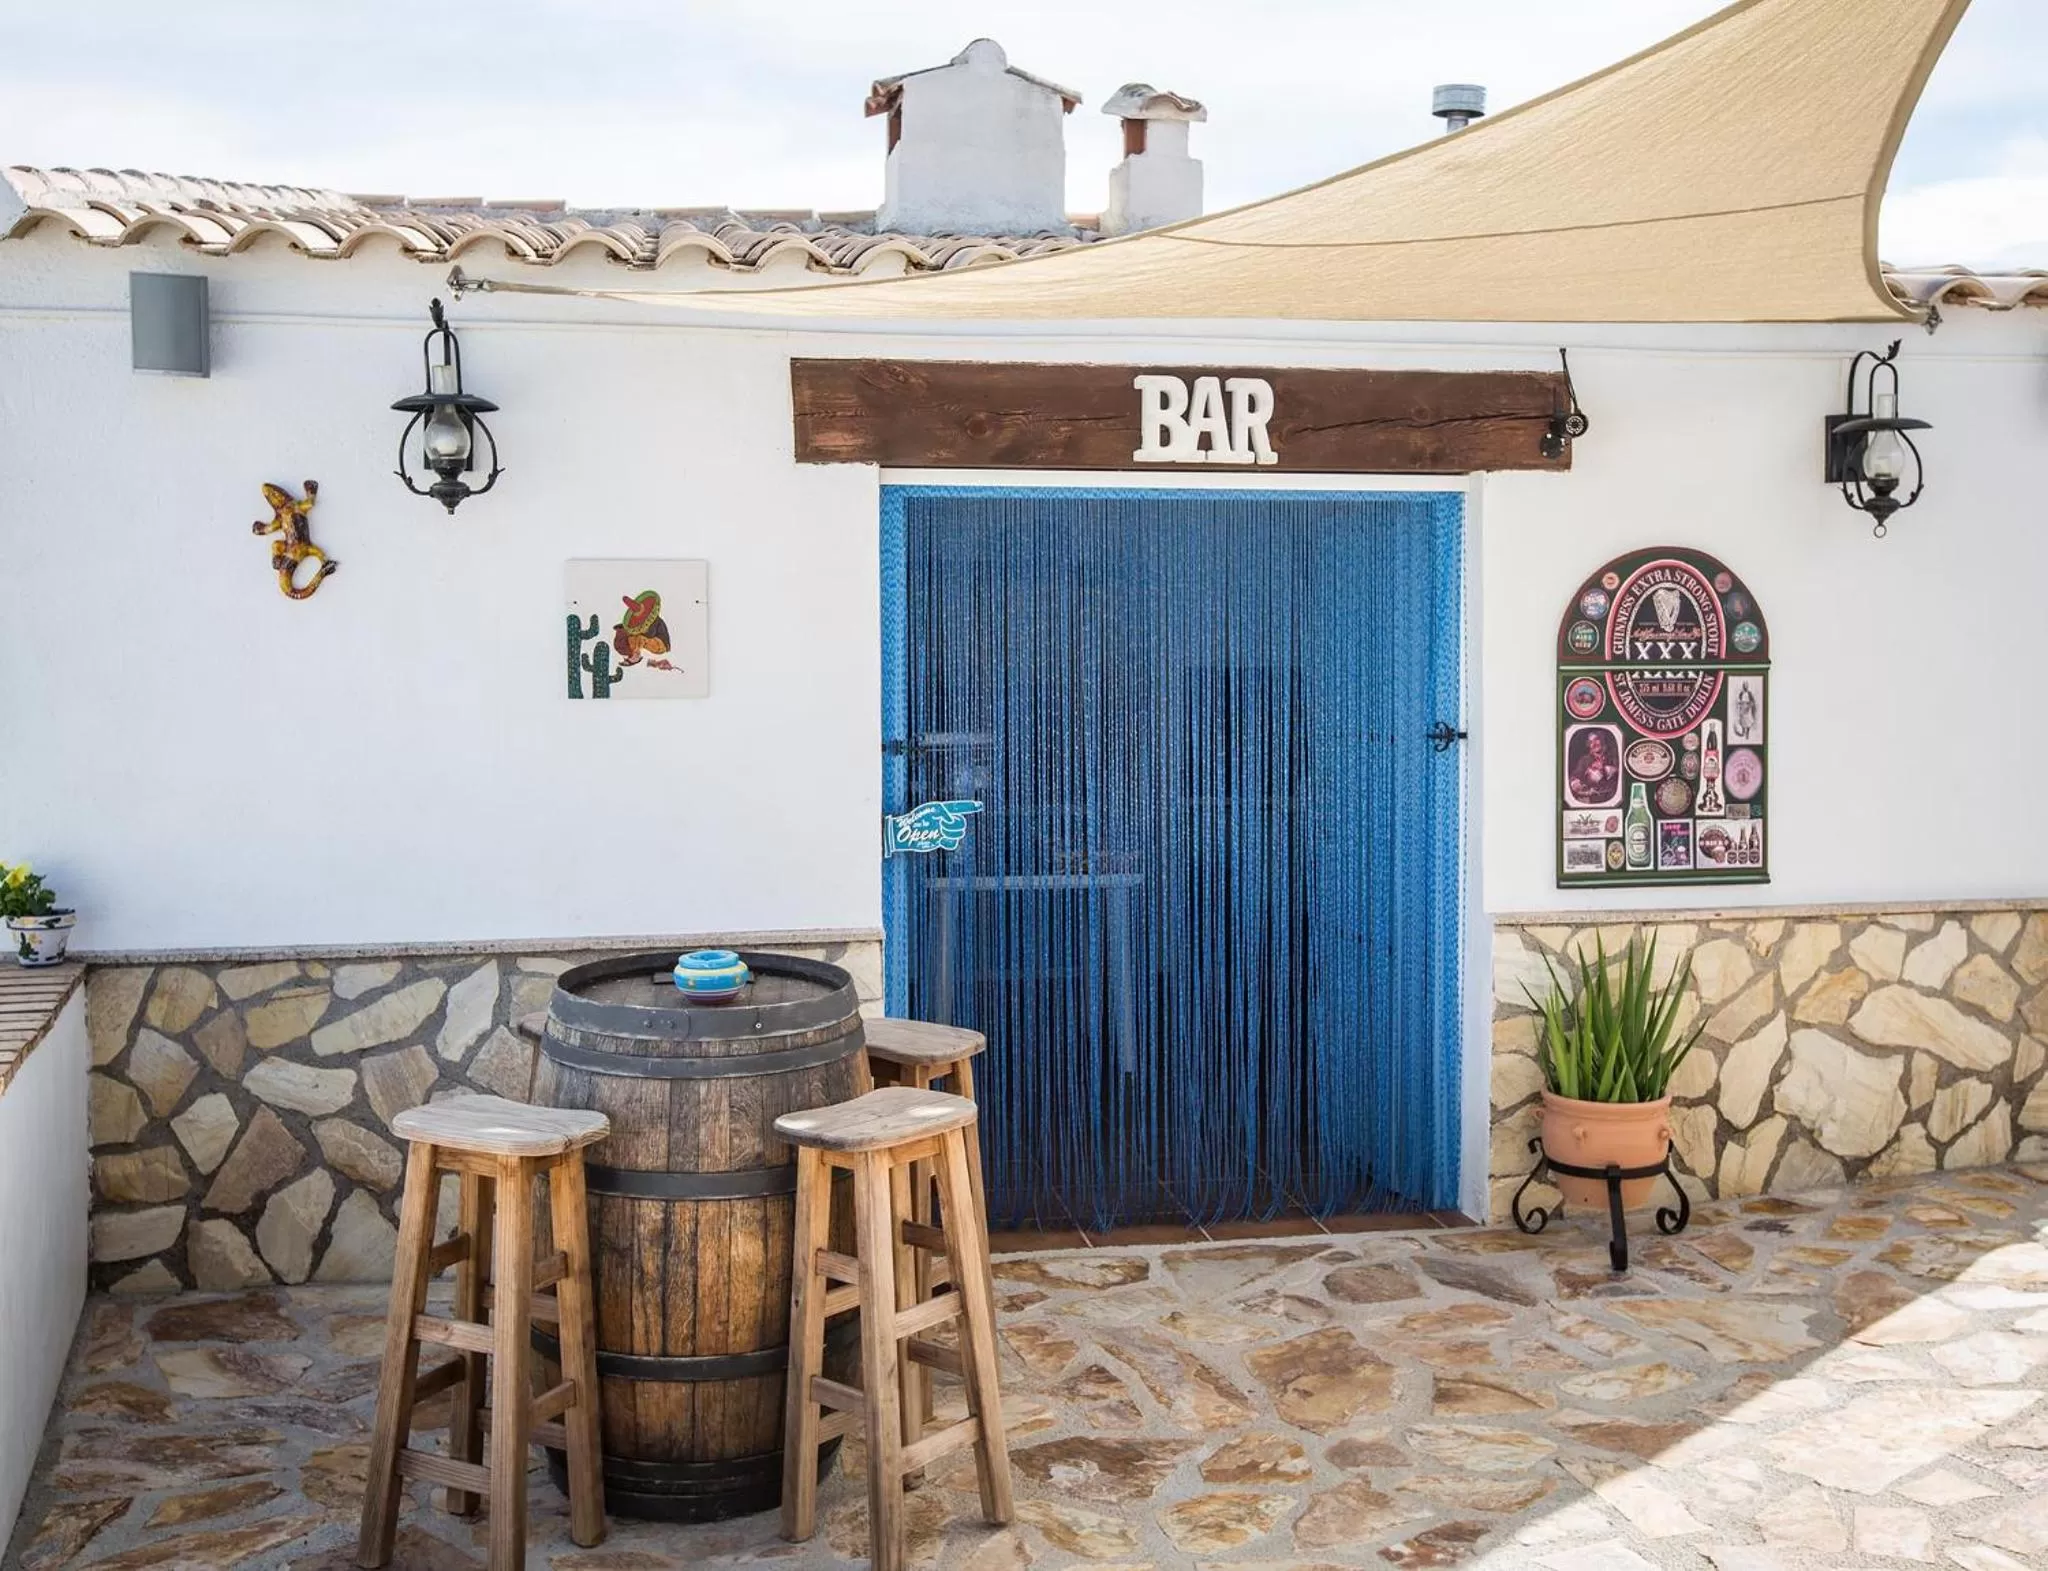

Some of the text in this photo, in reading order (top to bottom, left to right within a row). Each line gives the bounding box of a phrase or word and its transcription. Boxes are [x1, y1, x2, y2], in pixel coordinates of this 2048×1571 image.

[1133, 375, 1278, 464] BAR
[1613, 593, 1636, 655] GUINNESS
[1631, 569, 1672, 596] EXTRA
[1673, 569, 1713, 612] STRONG
[1705, 612, 1719, 655] STOUT
[1657, 715, 1687, 730] GATE
[1685, 674, 1716, 719] DUBLIN
[896, 825, 940, 847] Open
